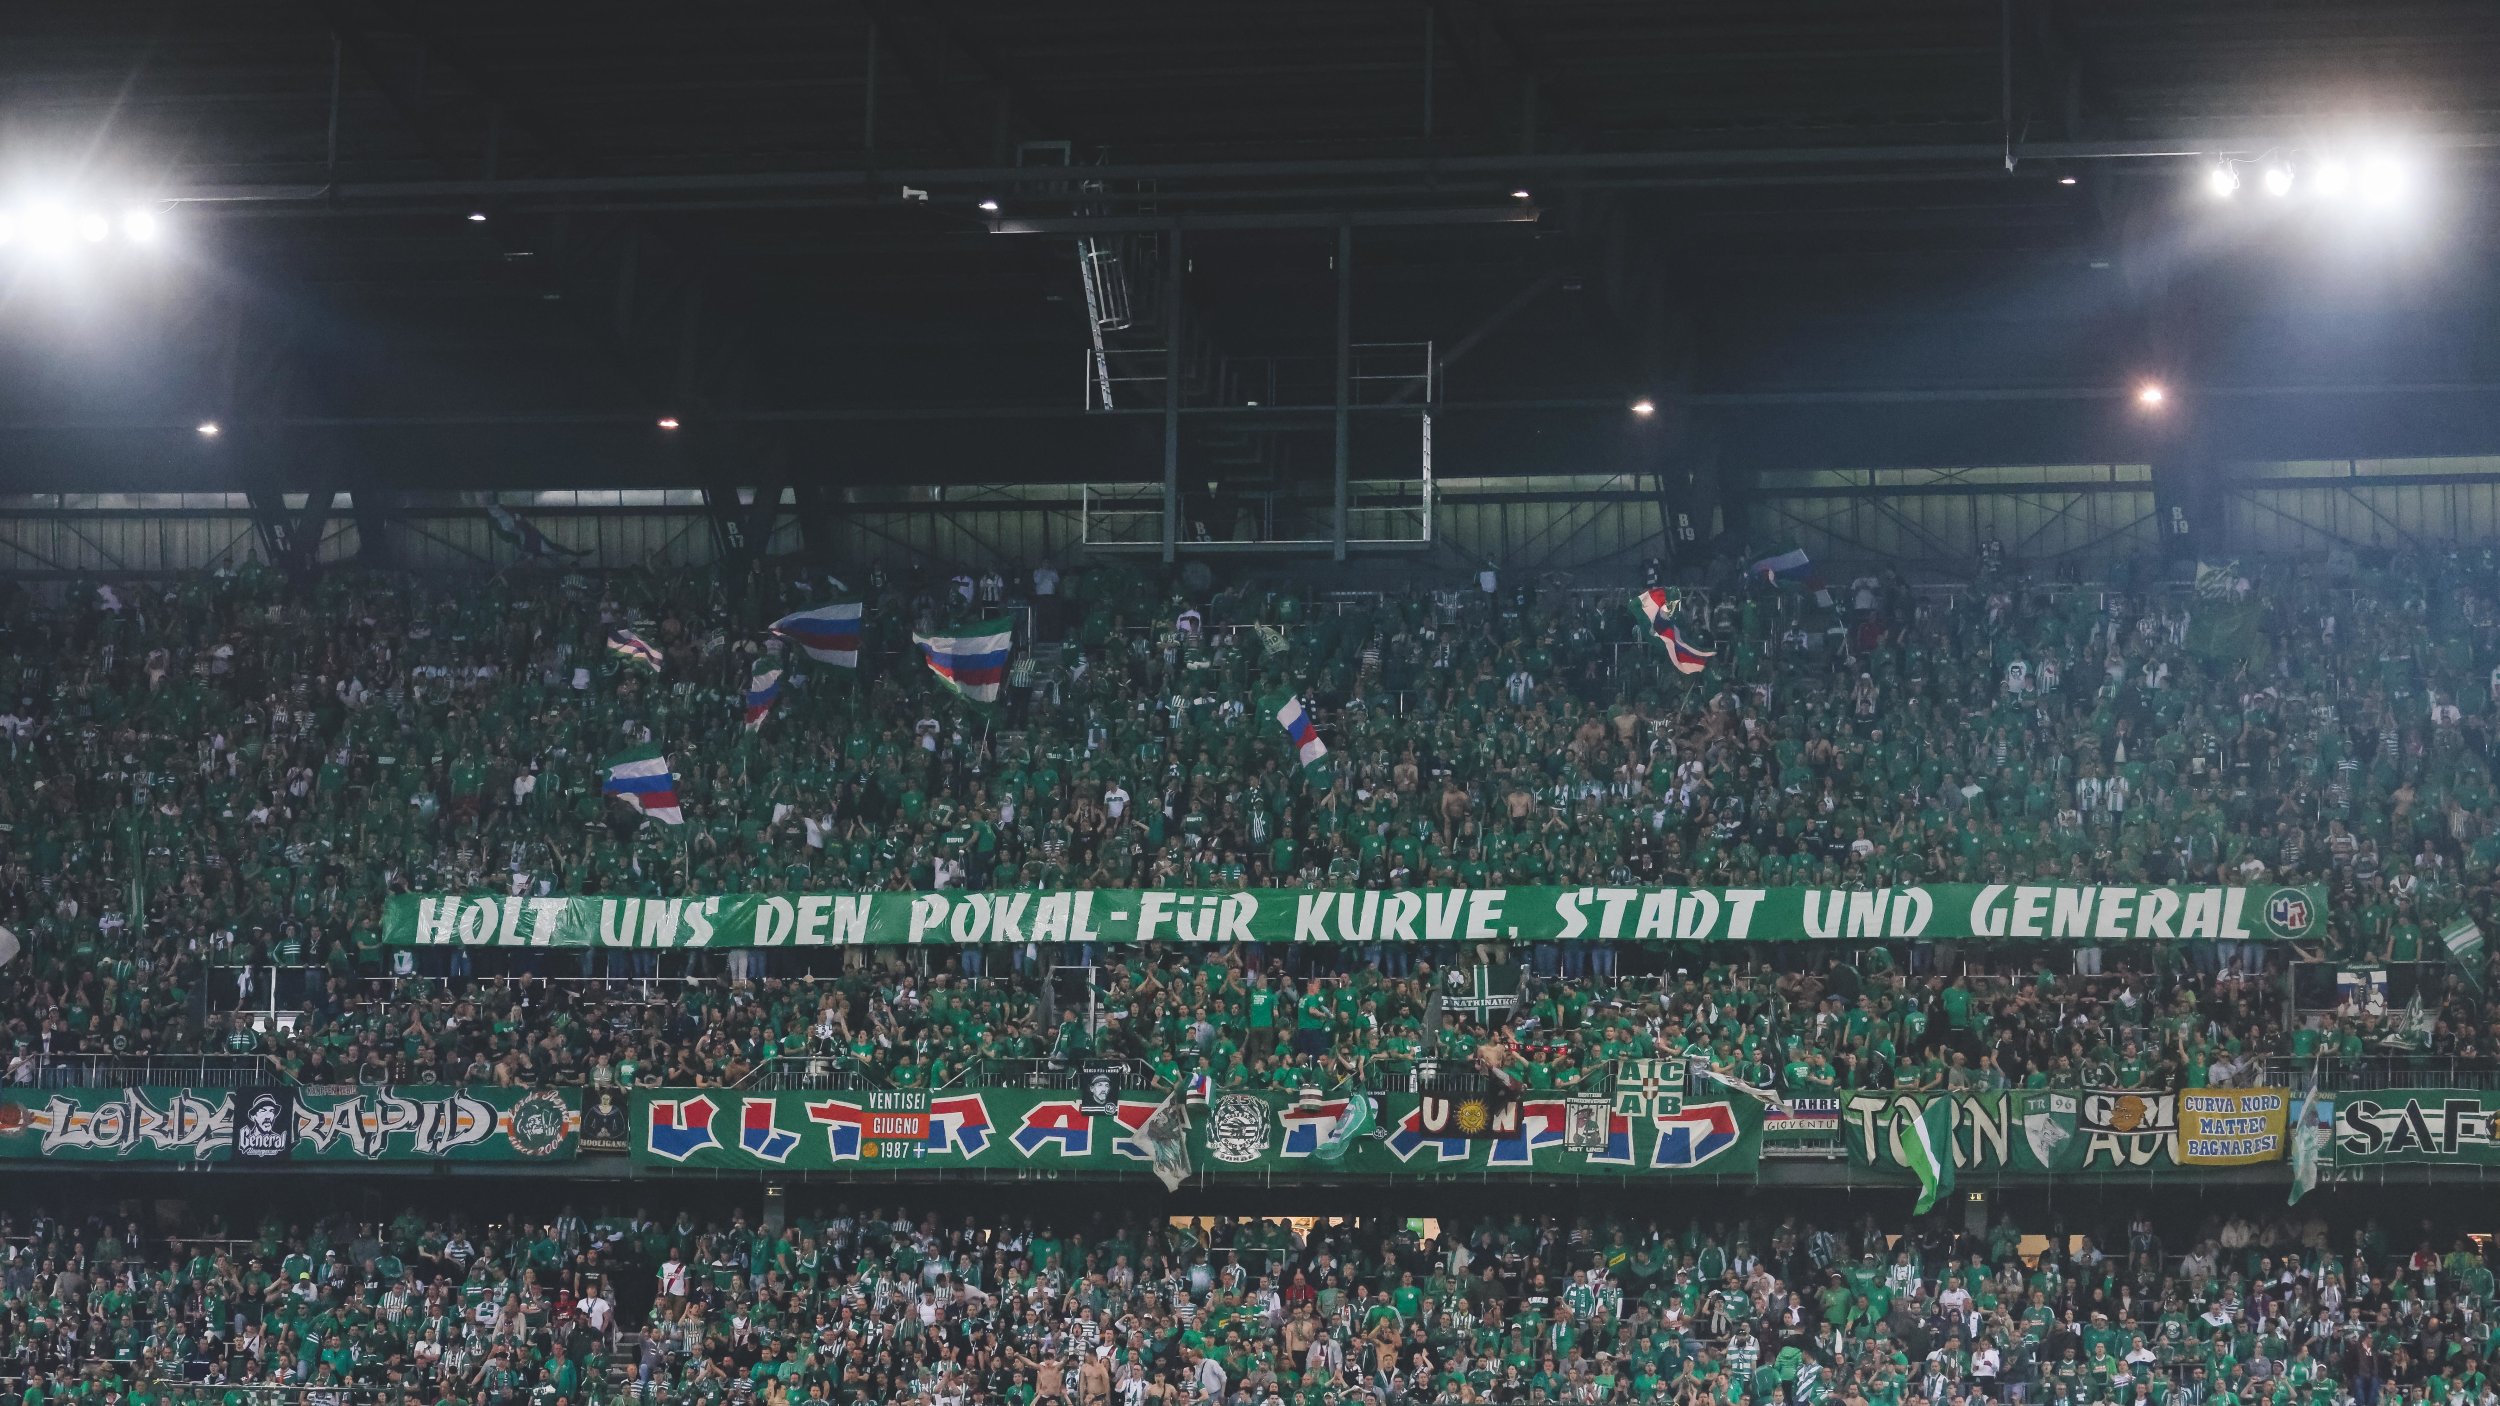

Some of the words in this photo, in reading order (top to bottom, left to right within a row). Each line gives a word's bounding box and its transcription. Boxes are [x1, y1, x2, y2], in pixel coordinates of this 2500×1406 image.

[727, 522, 738, 534] B
[1679, 513, 1688, 526] B
[728, 534, 743, 548] 17
[1678, 527, 1695, 540] 19
[416, 896, 568, 945] HOLT
[600, 896, 719, 947] UNS
[753, 895, 873, 945] DEN
[1556, 888, 1766, 938] STADT
[1802, 887, 1932, 938] UND
[1970, 885, 2250, 939] GENERAL
[1442, 997, 1518, 1006] PNATHINAIKO
[869, 1092, 926, 1110] VENTISEI
[2028, 1100, 2046, 1111] TR
[2055, 1099, 2072, 1110] 96
[2184, 1096, 2236, 1113] CURVA
[2240, 1095, 2282, 1112] NORD
[290, 1084, 498, 1160] RAPID
[873, 1117, 919, 1135] GIUGNO
[2200, 1116, 2268, 1136] MATTEO
[239, 1122, 287, 1150] General
[538, 1133, 564, 1155] 2004
[880, 1142, 910, 1159] 1987
[2187, 1135, 2278, 1156] BAGNARESI
